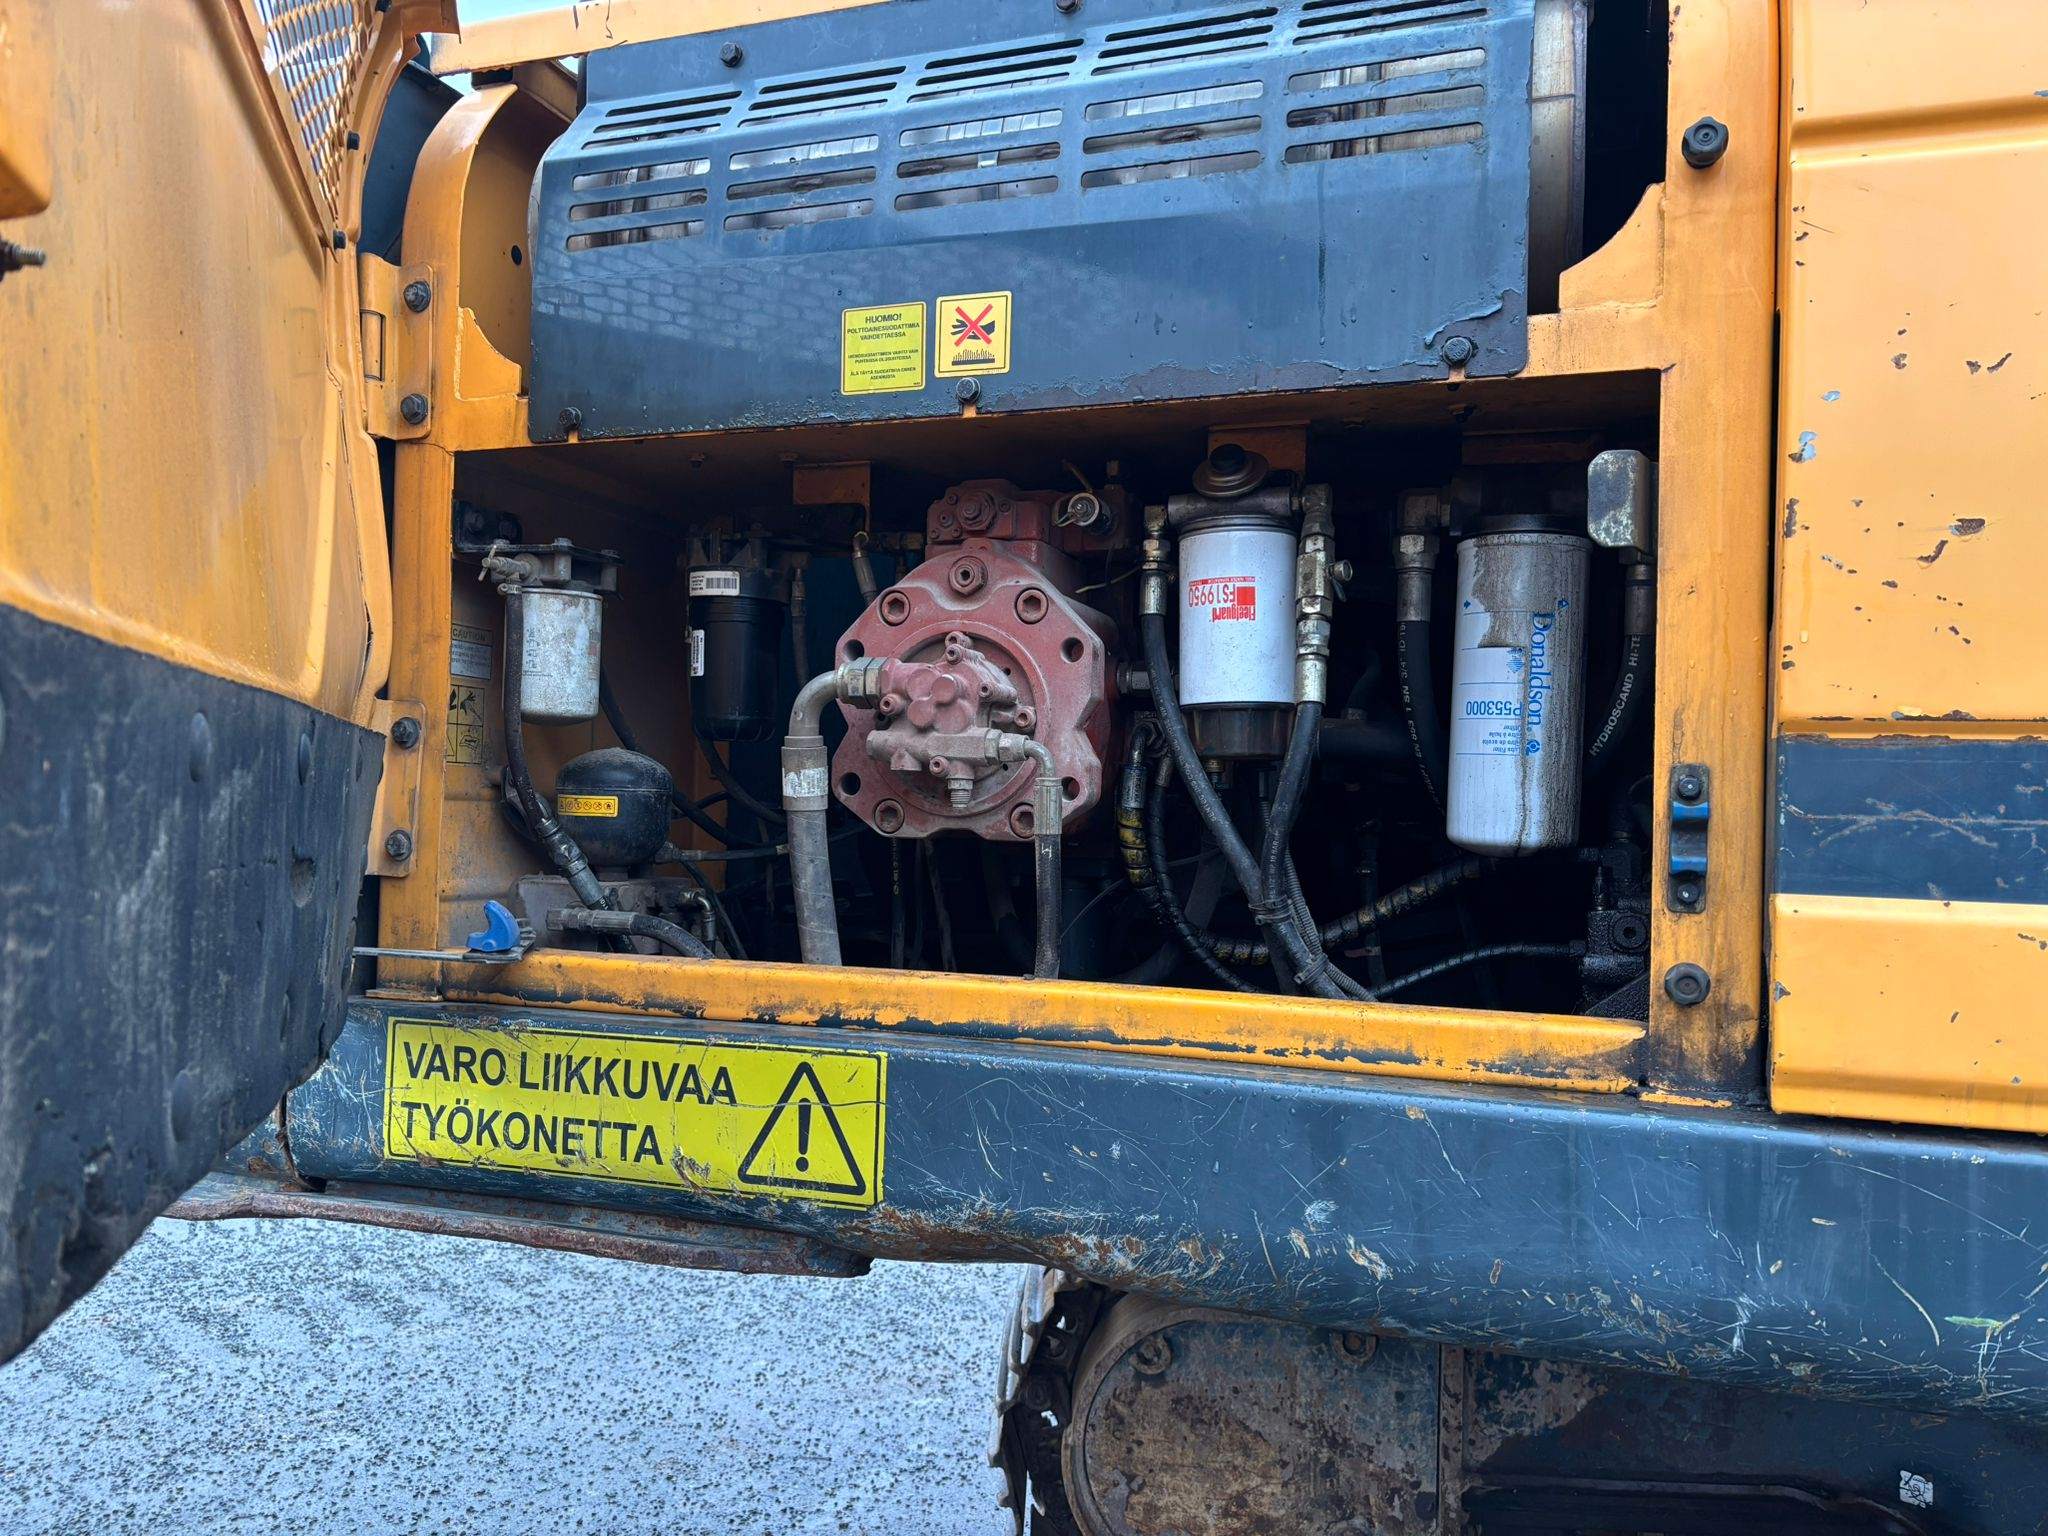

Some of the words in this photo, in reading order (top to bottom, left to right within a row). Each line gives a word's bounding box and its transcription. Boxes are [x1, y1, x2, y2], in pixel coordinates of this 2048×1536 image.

[865, 313, 902, 324] HUOMIO!
[860, 332, 906, 341] VAIHDETTAESSA
[1188, 583, 1236, 608] FS19950
[1212, 603, 1255, 623] Fleetguard
[453, 628, 487, 642] CAUTION
[1465, 700, 1523, 717] P553000
[1589, 673, 1634, 756] HYDROSCAND
[402, 1040, 507, 1087] VARO
[519, 1050, 739, 1107] LIIKKUVAA
[400, 1097, 664, 1166] TYÖKONETTA
